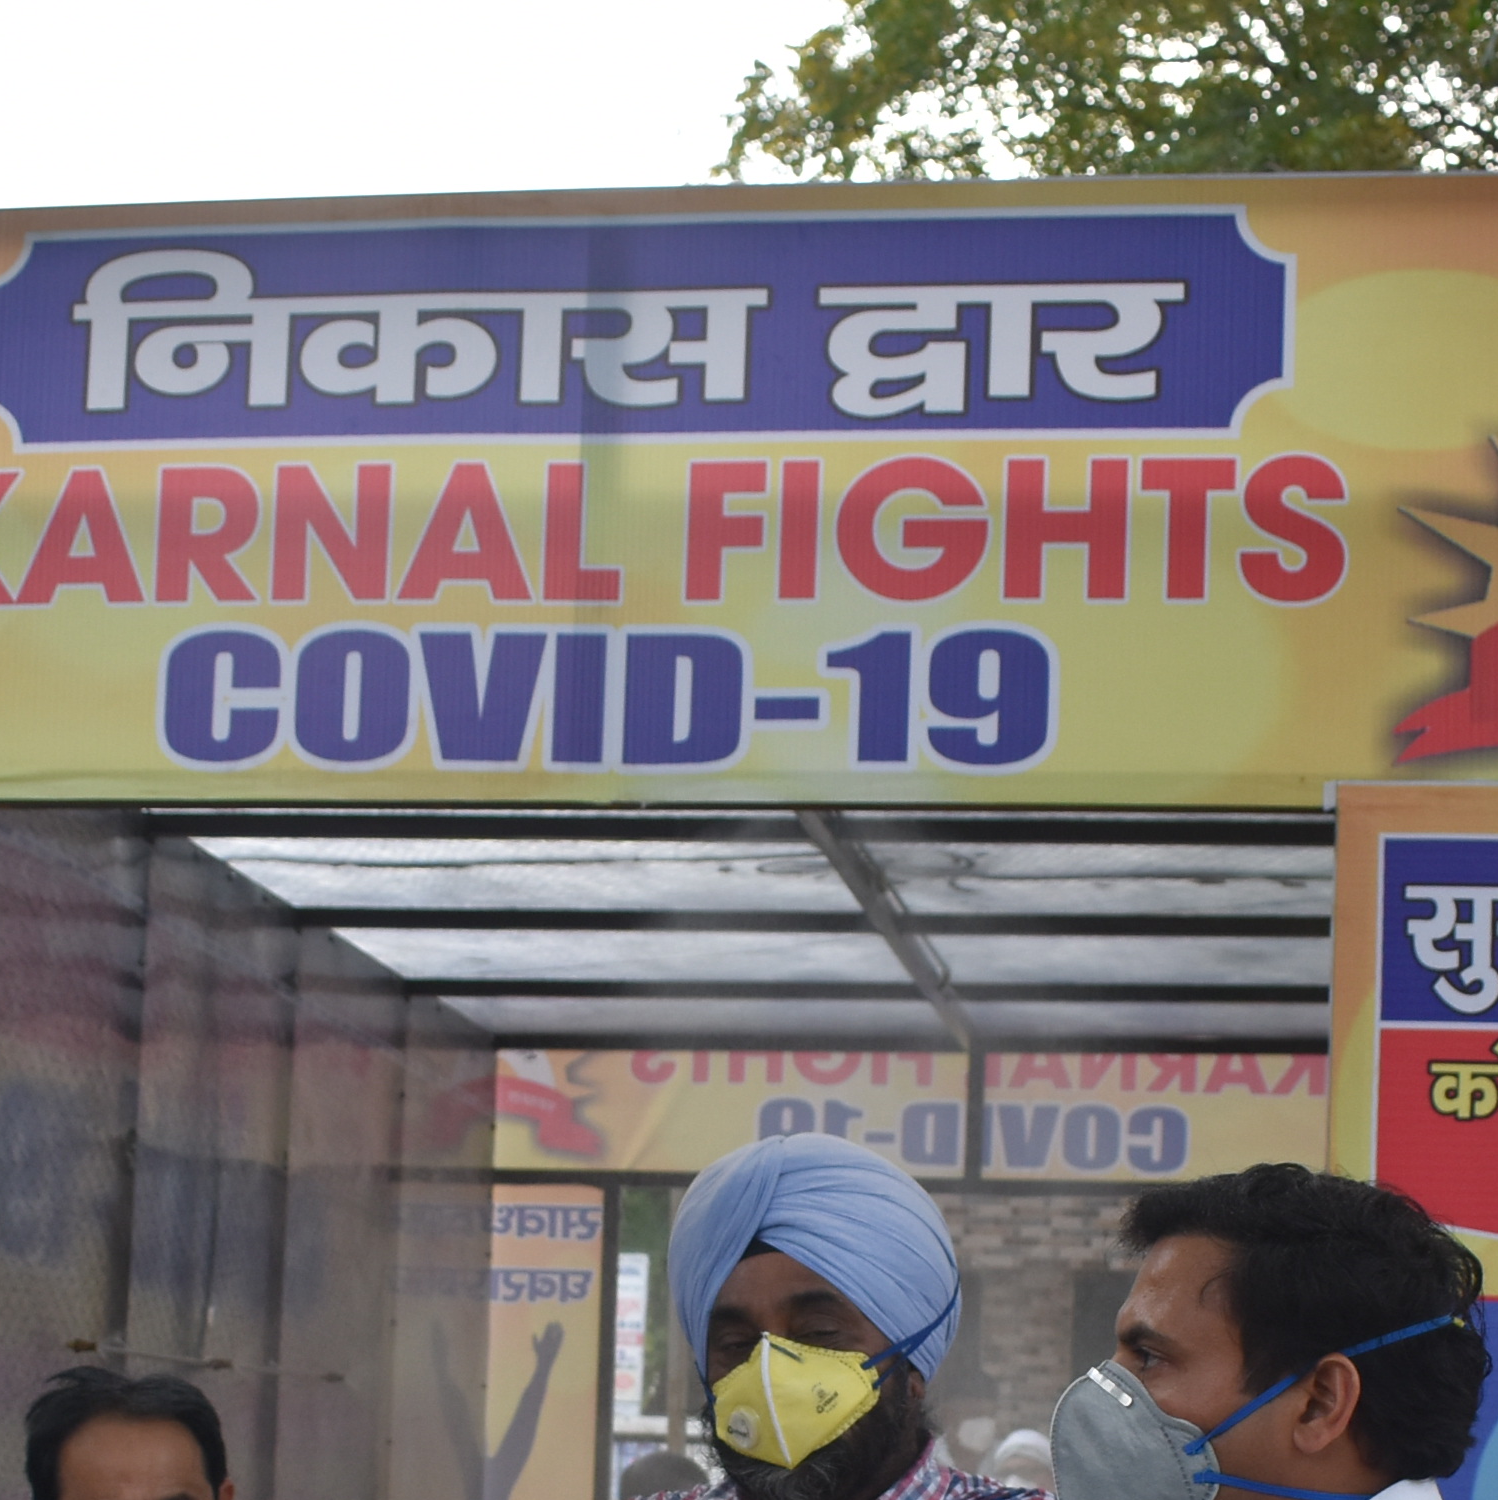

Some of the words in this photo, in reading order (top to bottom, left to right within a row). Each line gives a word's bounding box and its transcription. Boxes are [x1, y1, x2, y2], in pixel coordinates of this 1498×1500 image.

[74, 248, 769, 411] निकास
[818, 281, 1186, 419] द्वार
[683, 454, 1348, 605] FIGHTS
[164, 625, 1052, 769] COVID-19
